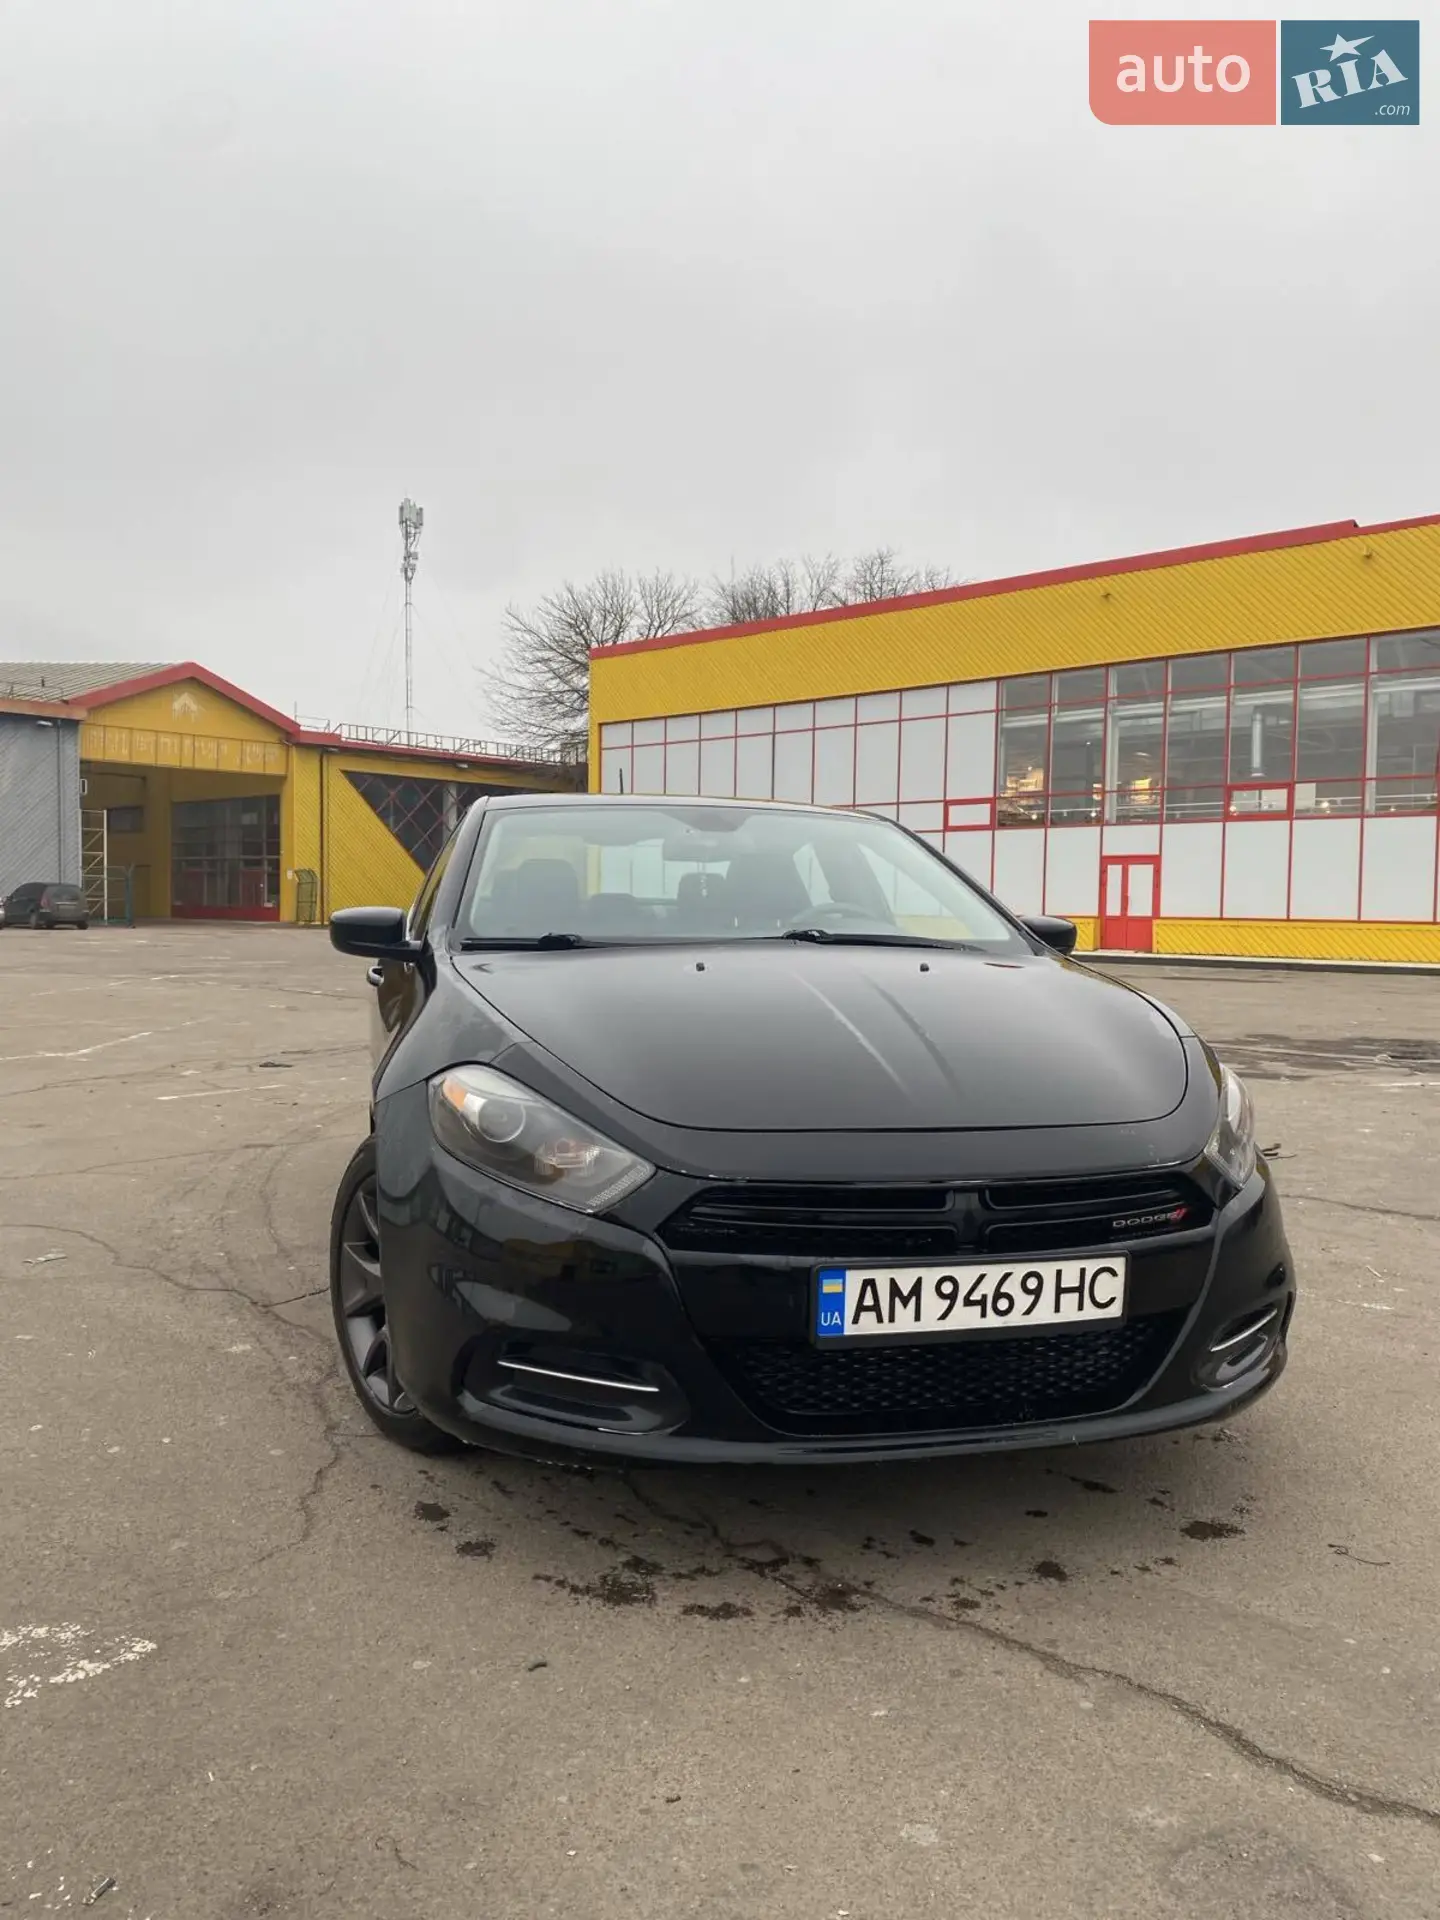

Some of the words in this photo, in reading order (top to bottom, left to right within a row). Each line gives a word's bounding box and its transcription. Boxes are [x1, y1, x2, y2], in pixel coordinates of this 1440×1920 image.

[1112, 1211, 1177, 1228] DODGE
[851, 1276, 923, 1325] AM
[934, 1270, 1045, 1321] 9469
[1053, 1266, 1119, 1314] HC
[820, 1311, 842, 1327] UA
